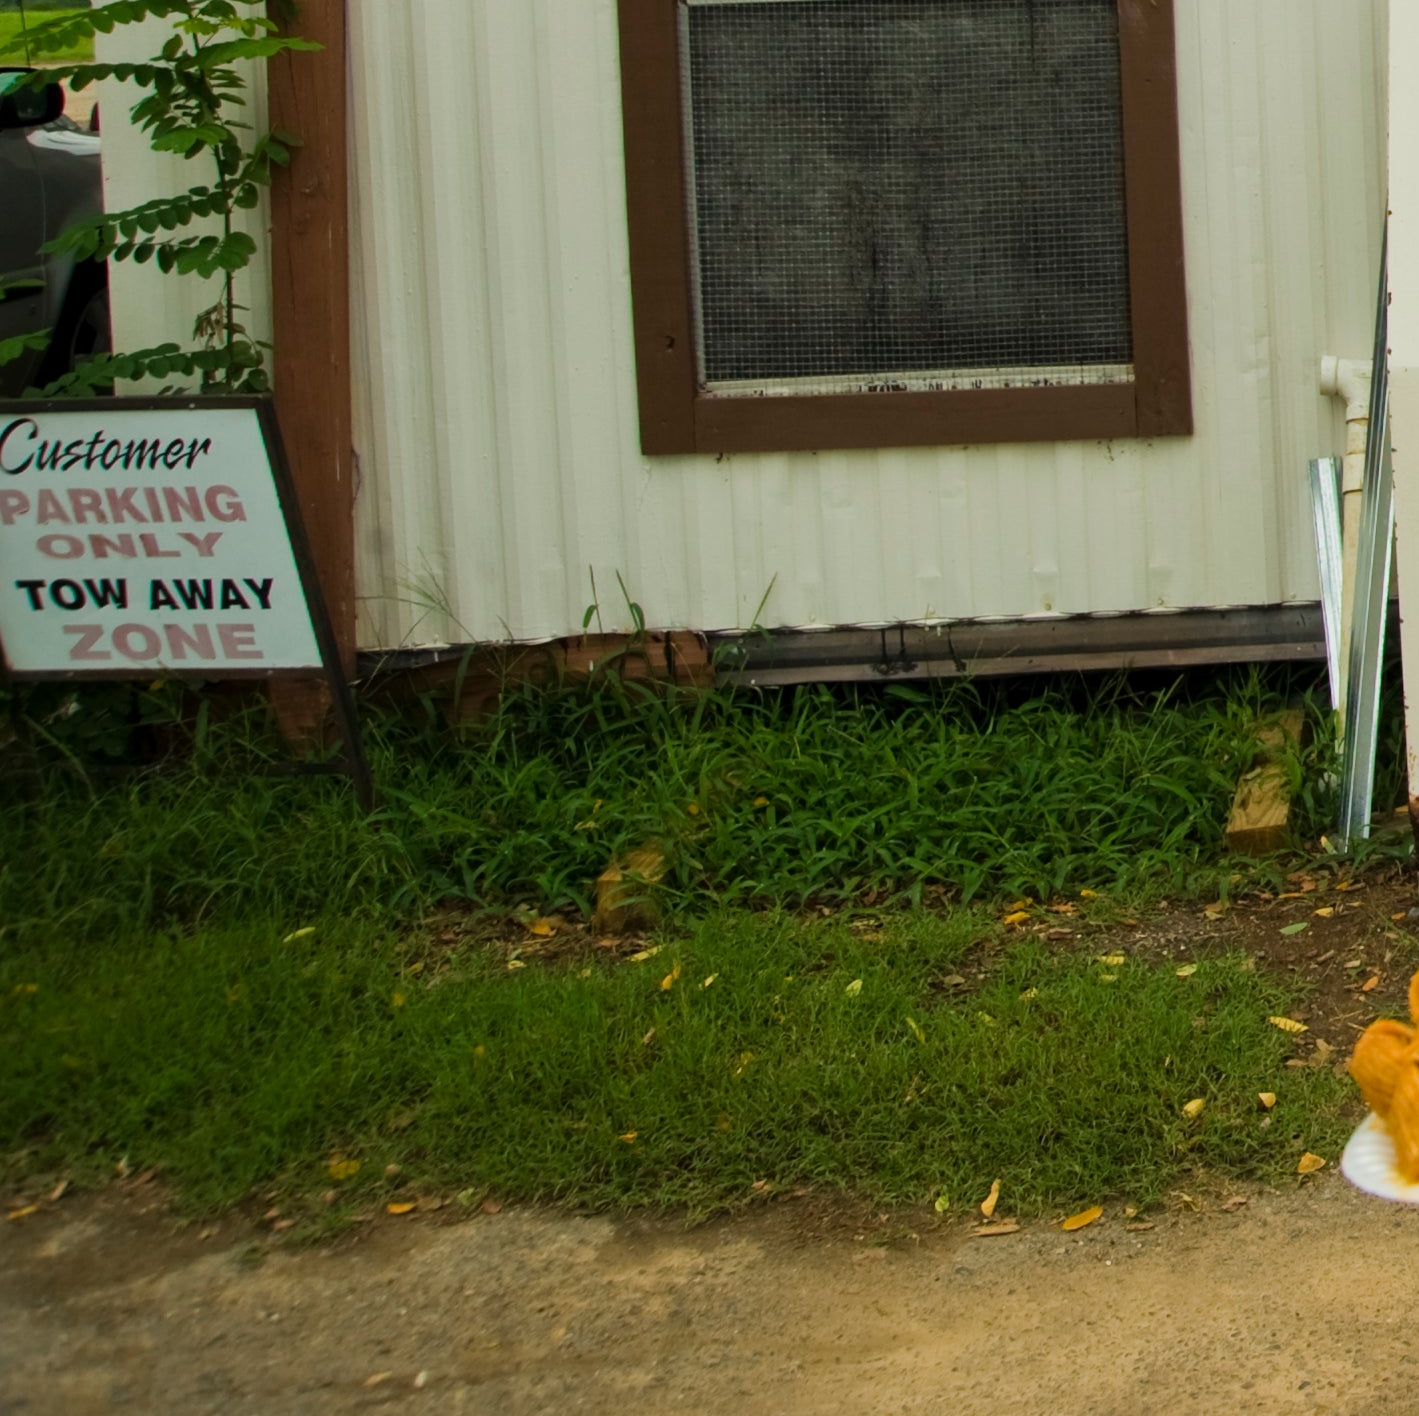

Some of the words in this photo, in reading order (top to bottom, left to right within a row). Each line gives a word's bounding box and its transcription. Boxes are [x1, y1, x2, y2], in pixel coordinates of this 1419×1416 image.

[0, 416, 212, 476] Customer
[0, 484, 248, 526] PARKING
[35, 532, 225, 560] ONLY
[14, 577, 128, 612] TOW
[149, 577, 274, 611] AWAY
[61, 622, 265, 662] ZONE
